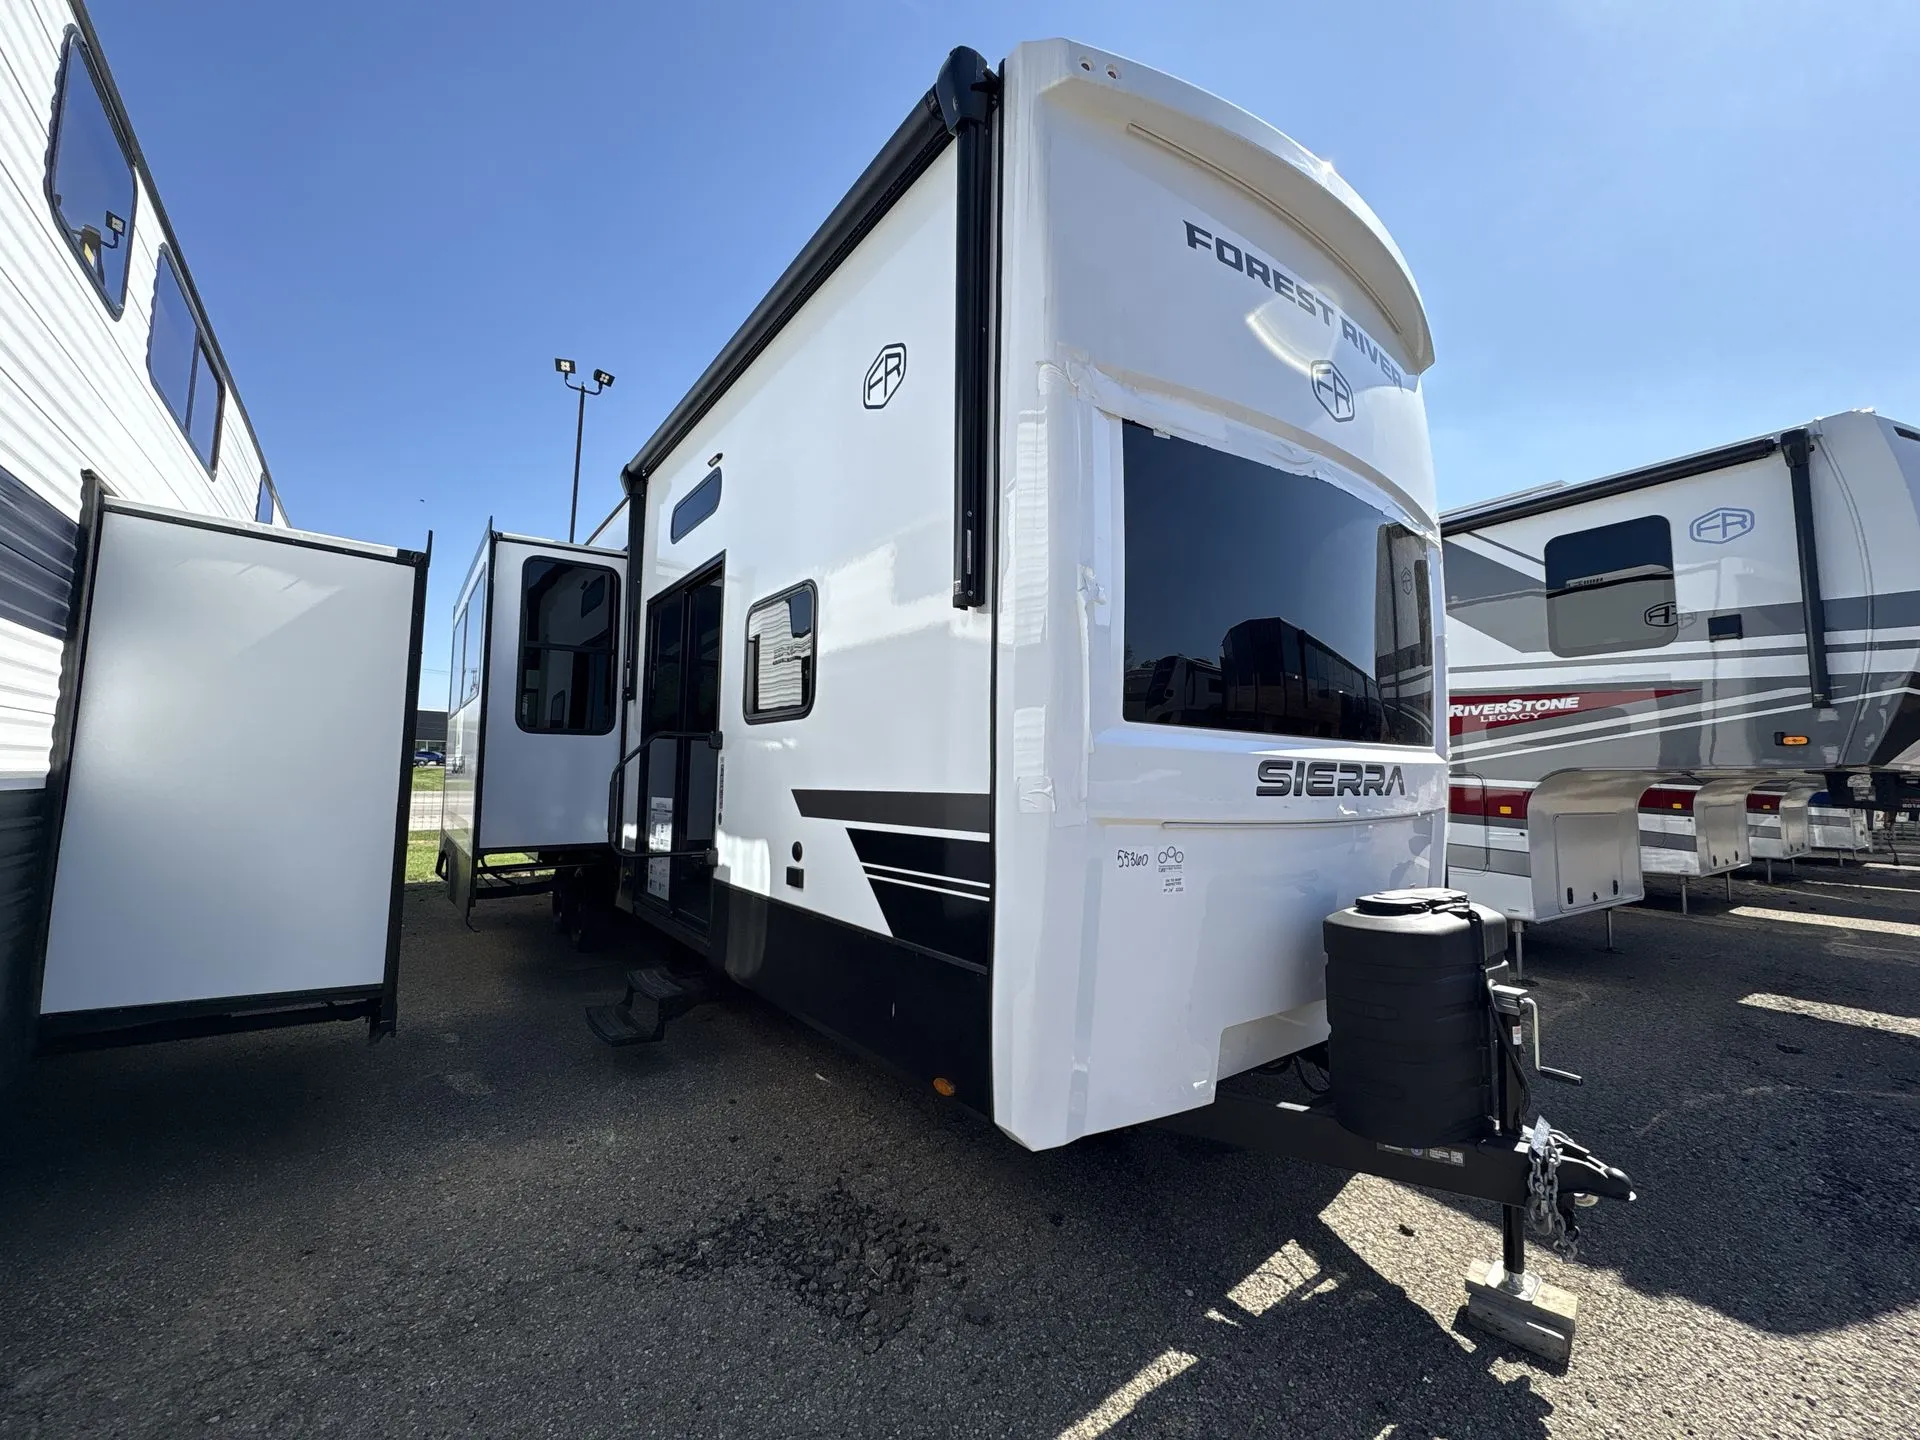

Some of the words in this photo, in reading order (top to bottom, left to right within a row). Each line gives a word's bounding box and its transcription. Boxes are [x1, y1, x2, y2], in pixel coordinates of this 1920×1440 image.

[1183, 219, 1335, 325] FOREST
[1340, 316, 1403, 392] RIVER
[1449, 696, 1580, 717] RIVERSTONE
[1479, 712, 1541, 722] LEGACY
[1256, 759, 1406, 797] SIERRA
